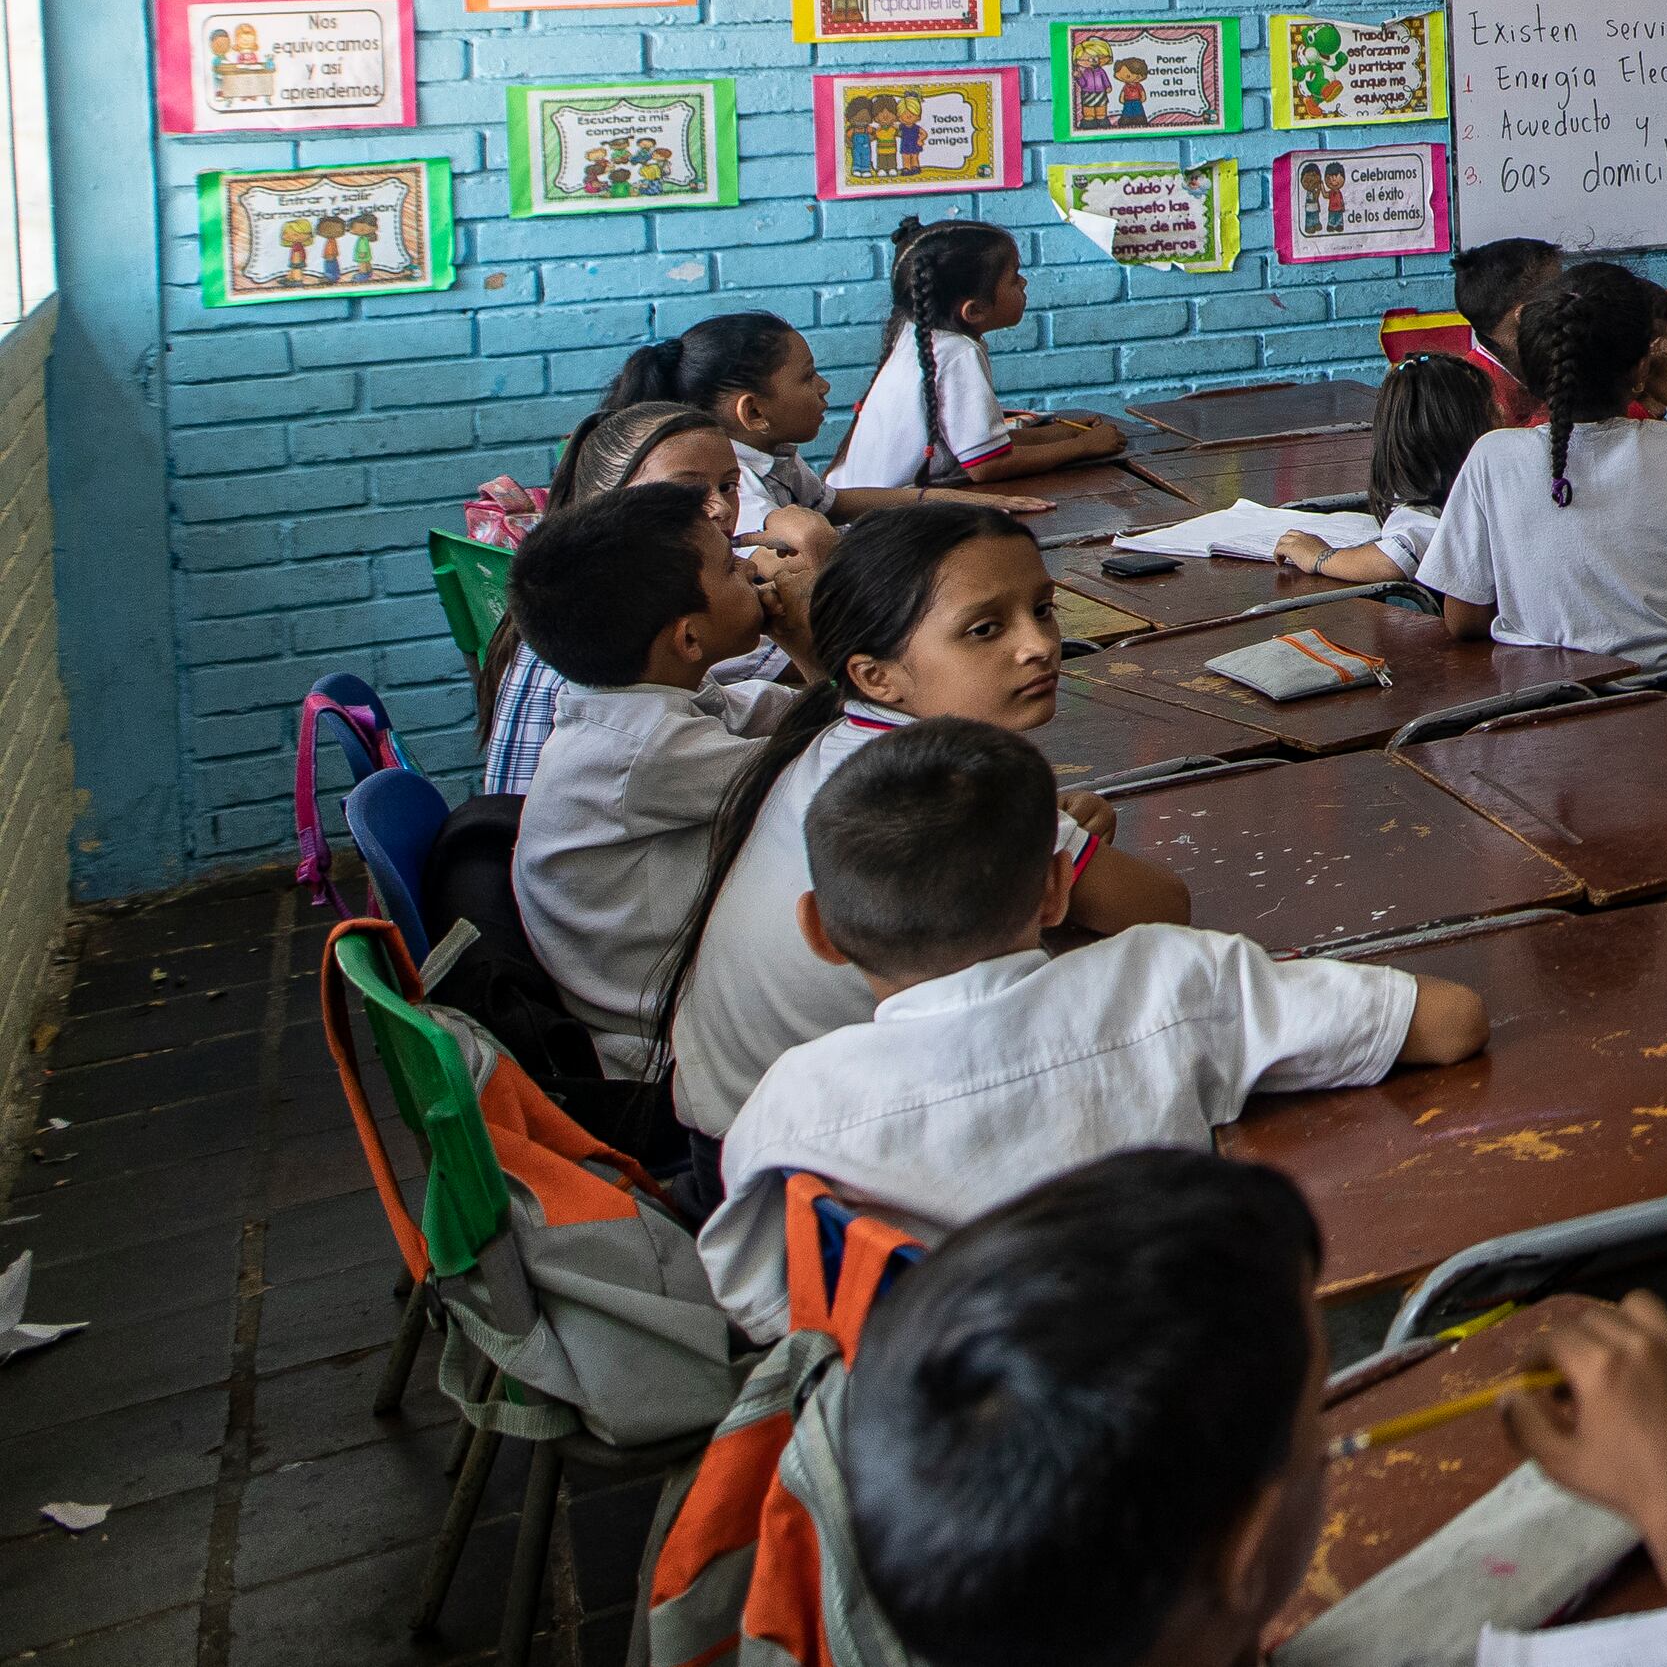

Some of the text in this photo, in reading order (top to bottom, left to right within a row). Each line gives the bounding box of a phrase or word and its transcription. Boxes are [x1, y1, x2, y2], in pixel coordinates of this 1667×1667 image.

[308, 14, 338, 31] Nos
[1470, 4, 1578, 47] Existen
[272, 37, 380, 55] equivocamos
[1347, 45, 1410, 57] esforzarme
[1156, 55, 1187, 64] Poner
[1150, 88, 1196, 98] maestra
[1496, 64, 1597, 109] Energía
[931, 114, 964, 124] Todos
[1501, 98, 1611, 141] Acueducto
[930, 126, 966, 135] somos
[928, 136, 969, 148] amigos
[1350, 168, 1418, 182] Celebramos
[1501, 156, 1551, 194] Gas
[1123, 182, 1161, 196] Cuido
[1378, 185, 1404, 201] éxito
[1110, 202, 1166, 220] respeto
[1347, 205, 1423, 224] de los demás.
[1112, 238, 1197, 255] ompañeros
